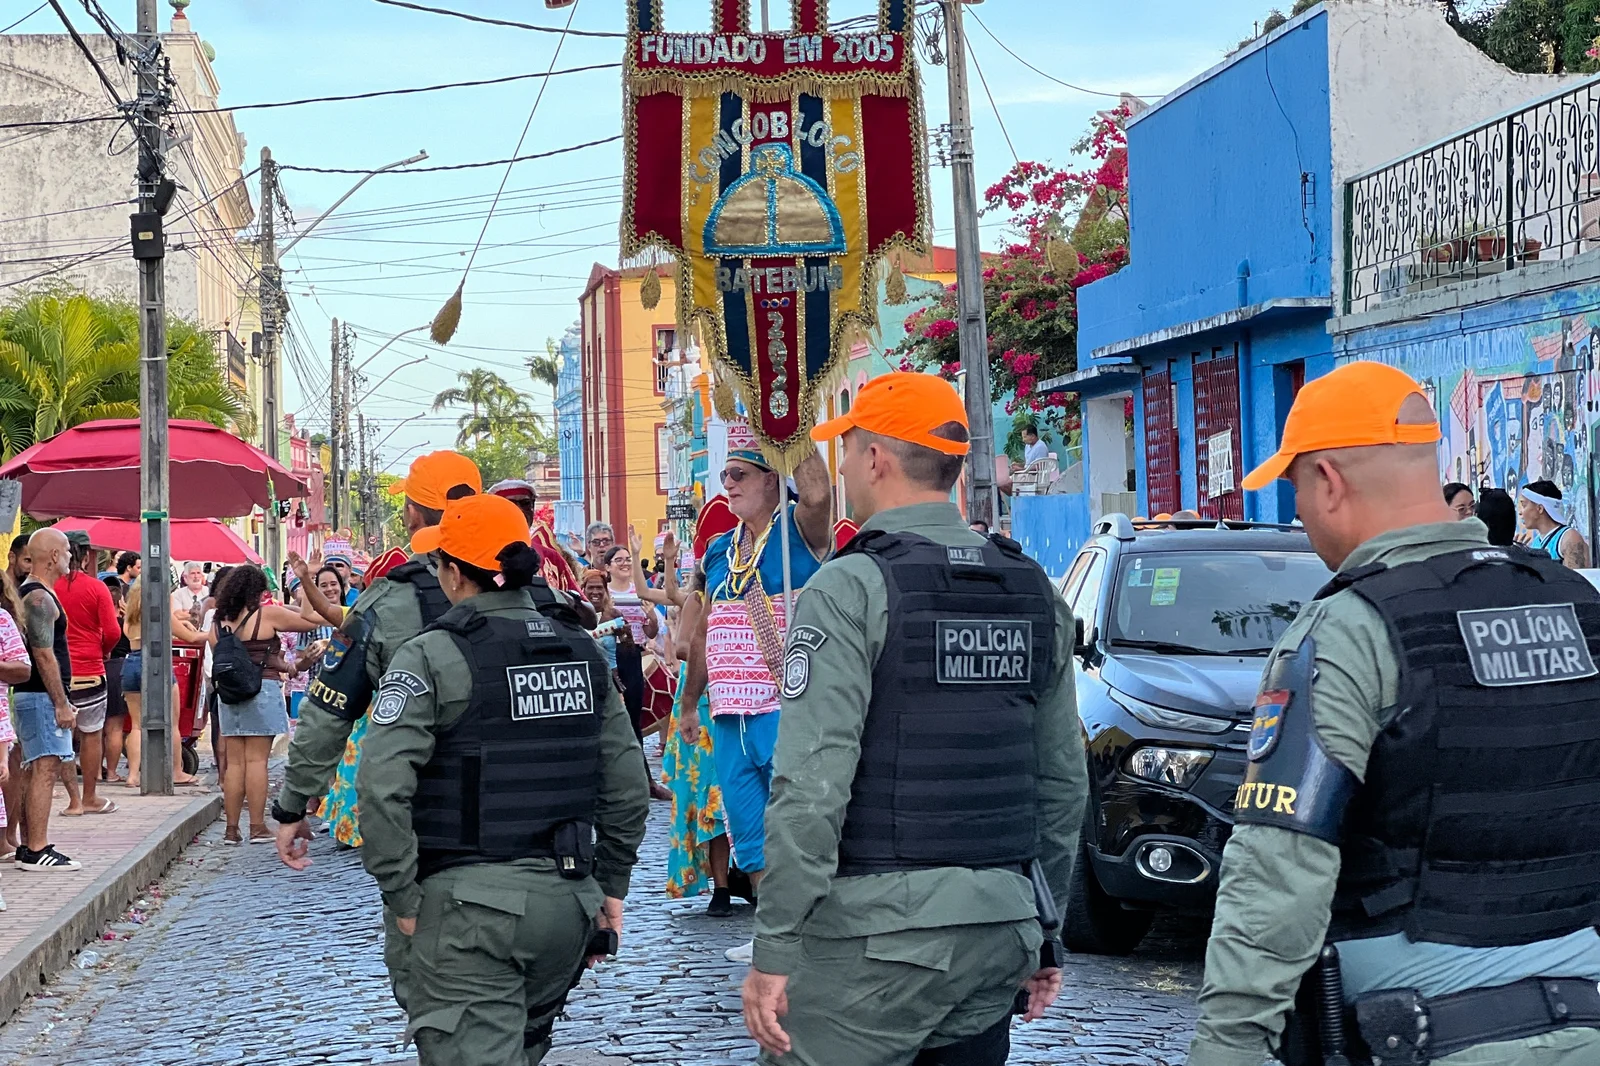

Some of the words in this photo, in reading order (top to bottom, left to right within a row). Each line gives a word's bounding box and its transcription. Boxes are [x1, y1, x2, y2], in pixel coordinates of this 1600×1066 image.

[641, 35, 767, 64] FUNDADO
[784, 35, 822, 63] EM
[833, 35, 894, 63] 2005
[715, 265, 843, 294] BATEBUM
[944, 624, 1026, 651] POLÍCIA
[1470, 610, 1576, 647] POLÍCIA
[945, 655, 1024, 678] MILITAR
[1480, 646, 1586, 680] MILITAR
[514, 667, 586, 693] POLÍCIA
[517, 691, 588, 715] MILITAR
